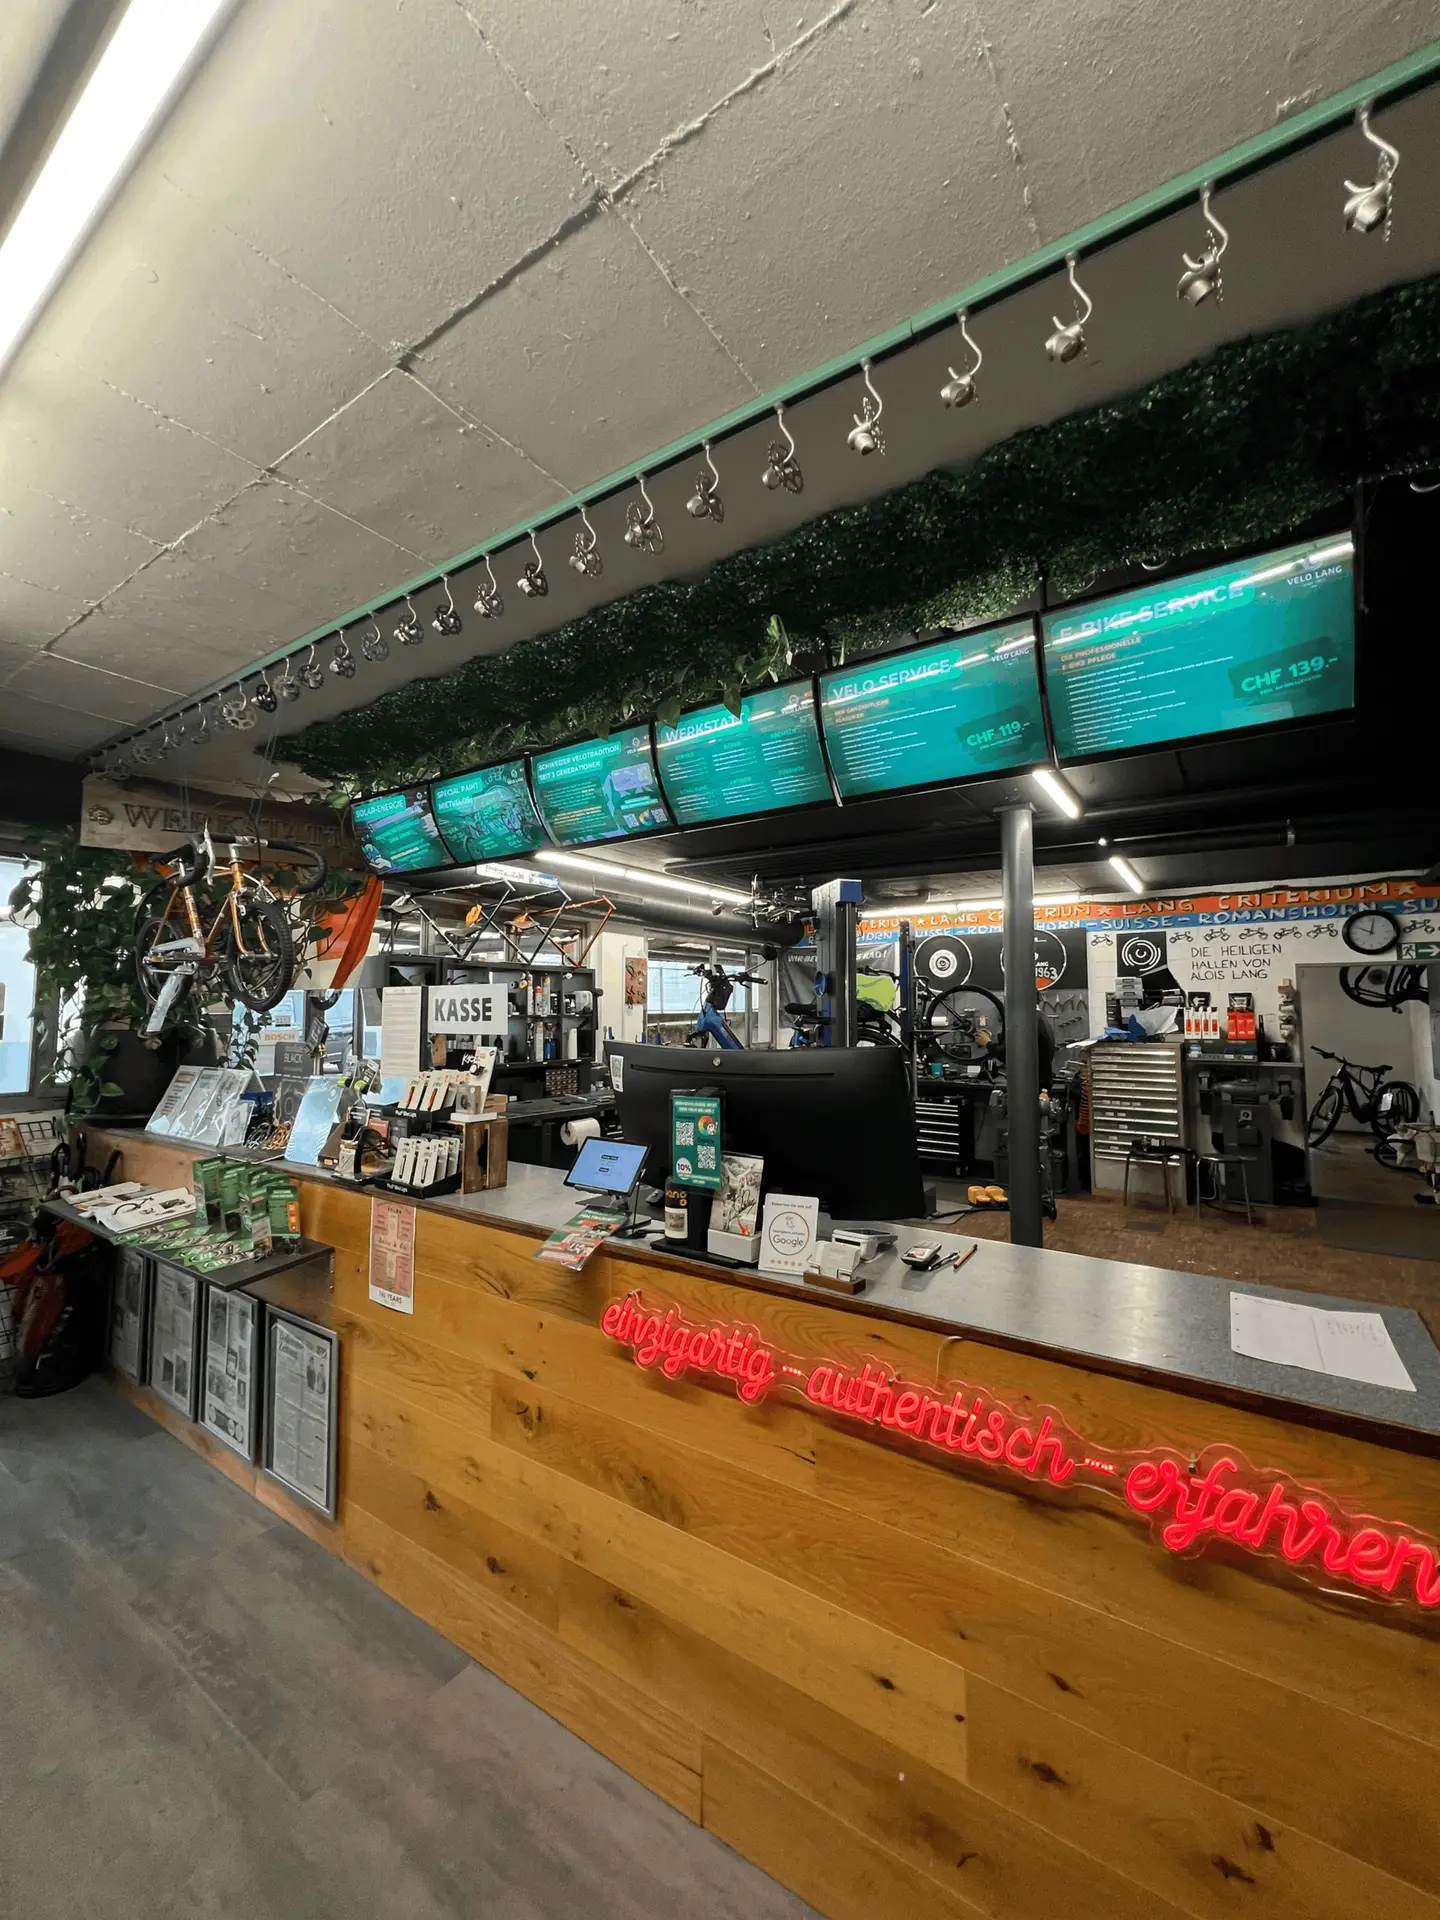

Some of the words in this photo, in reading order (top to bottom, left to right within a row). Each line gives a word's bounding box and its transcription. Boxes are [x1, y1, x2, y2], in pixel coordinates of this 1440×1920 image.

[1287, 573, 1312, 585] VELO
[1315, 565, 1342, 578] LANG
[1140, 585, 1245, 622] SERVICE
[992, 652, 1009, 662] VELO
[1010, 647, 1030, 657] LANG
[1088, 653, 1116, 664] PFLEGE
[833, 679, 874, 698] VELO
[879, 659, 951, 686] SERVICE
[1241, 668, 1282, 692] CHF
[1288, 656, 1338, 678] 139.-
[966, 728, 995, 746] CHF
[999, 721, 1030, 736] 119.-
[572, 744, 619, 763] VELOTRADITION
[556, 761, 601, 776] GENERATIONEN
[355, 800, 404, 818] SOLAR-ENERGIE
[930, 912, 979, 925] LANG
[1122, 899, 1194, 916] LANG
[1218, 883, 1389, 910] CRITERIUM
[1100, 918, 1173, 930] SUISSE
[1198, 903, 1377, 925] ROMANSHORN
[1403, 898, 1440, 914] SU
[1191, 946, 1209, 957] DIE
[1221, 944, 1282, 956] HEILIGEN
[1191, 959, 1238, 970] HALLEN
[1243, 958, 1271, 968] VON
[1035, 967, 1058, 980] 1963
[1190, 970, 1225, 981] ALOIS
[1232, 969, 1268, 980] LANG
[434, 997, 492, 1022] KASSE
[264, 1033, 297, 1041] BOSCH
[677, 1163, 691, 1172] 10%
[773, 1235, 804, 1248] Google
[602, 1298, 775, 1399] einzigartig
[807, 1363, 1076, 1481] authentisch
[1125, 1458, 1440, 1606] erfahren
